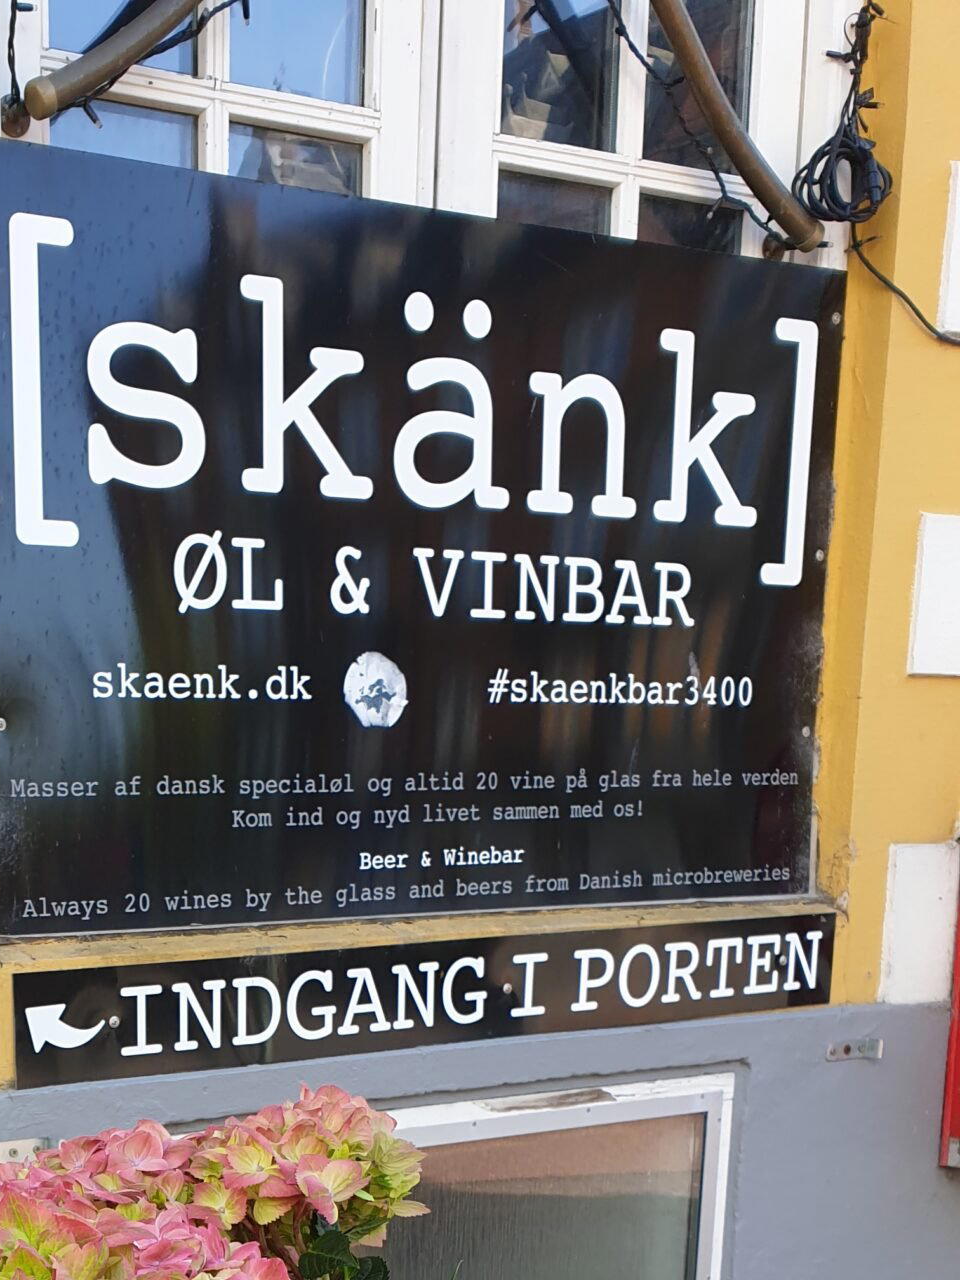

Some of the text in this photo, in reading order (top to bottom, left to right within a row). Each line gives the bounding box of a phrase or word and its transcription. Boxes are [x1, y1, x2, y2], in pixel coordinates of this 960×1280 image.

[173, 529, 696, 627] ØL & VINBAR
[92, 662, 313, 700] skaenk.dk
[487, 668, 753, 707] #skaenkbar3400
[10, 768, 799, 799] Masser af dansk specialøl og altid 20 vine på glas fra hele verden
[231, 800, 644, 830] Kom ind og nyd livet sammen med os!
[359, 846, 526, 870] Beer & Winebar
[22, 865, 791, 921] Always 20 wines by the glass and beers from Danish microbreweries
[120, 930, 823, 1057] INDGANG I PORTEN
